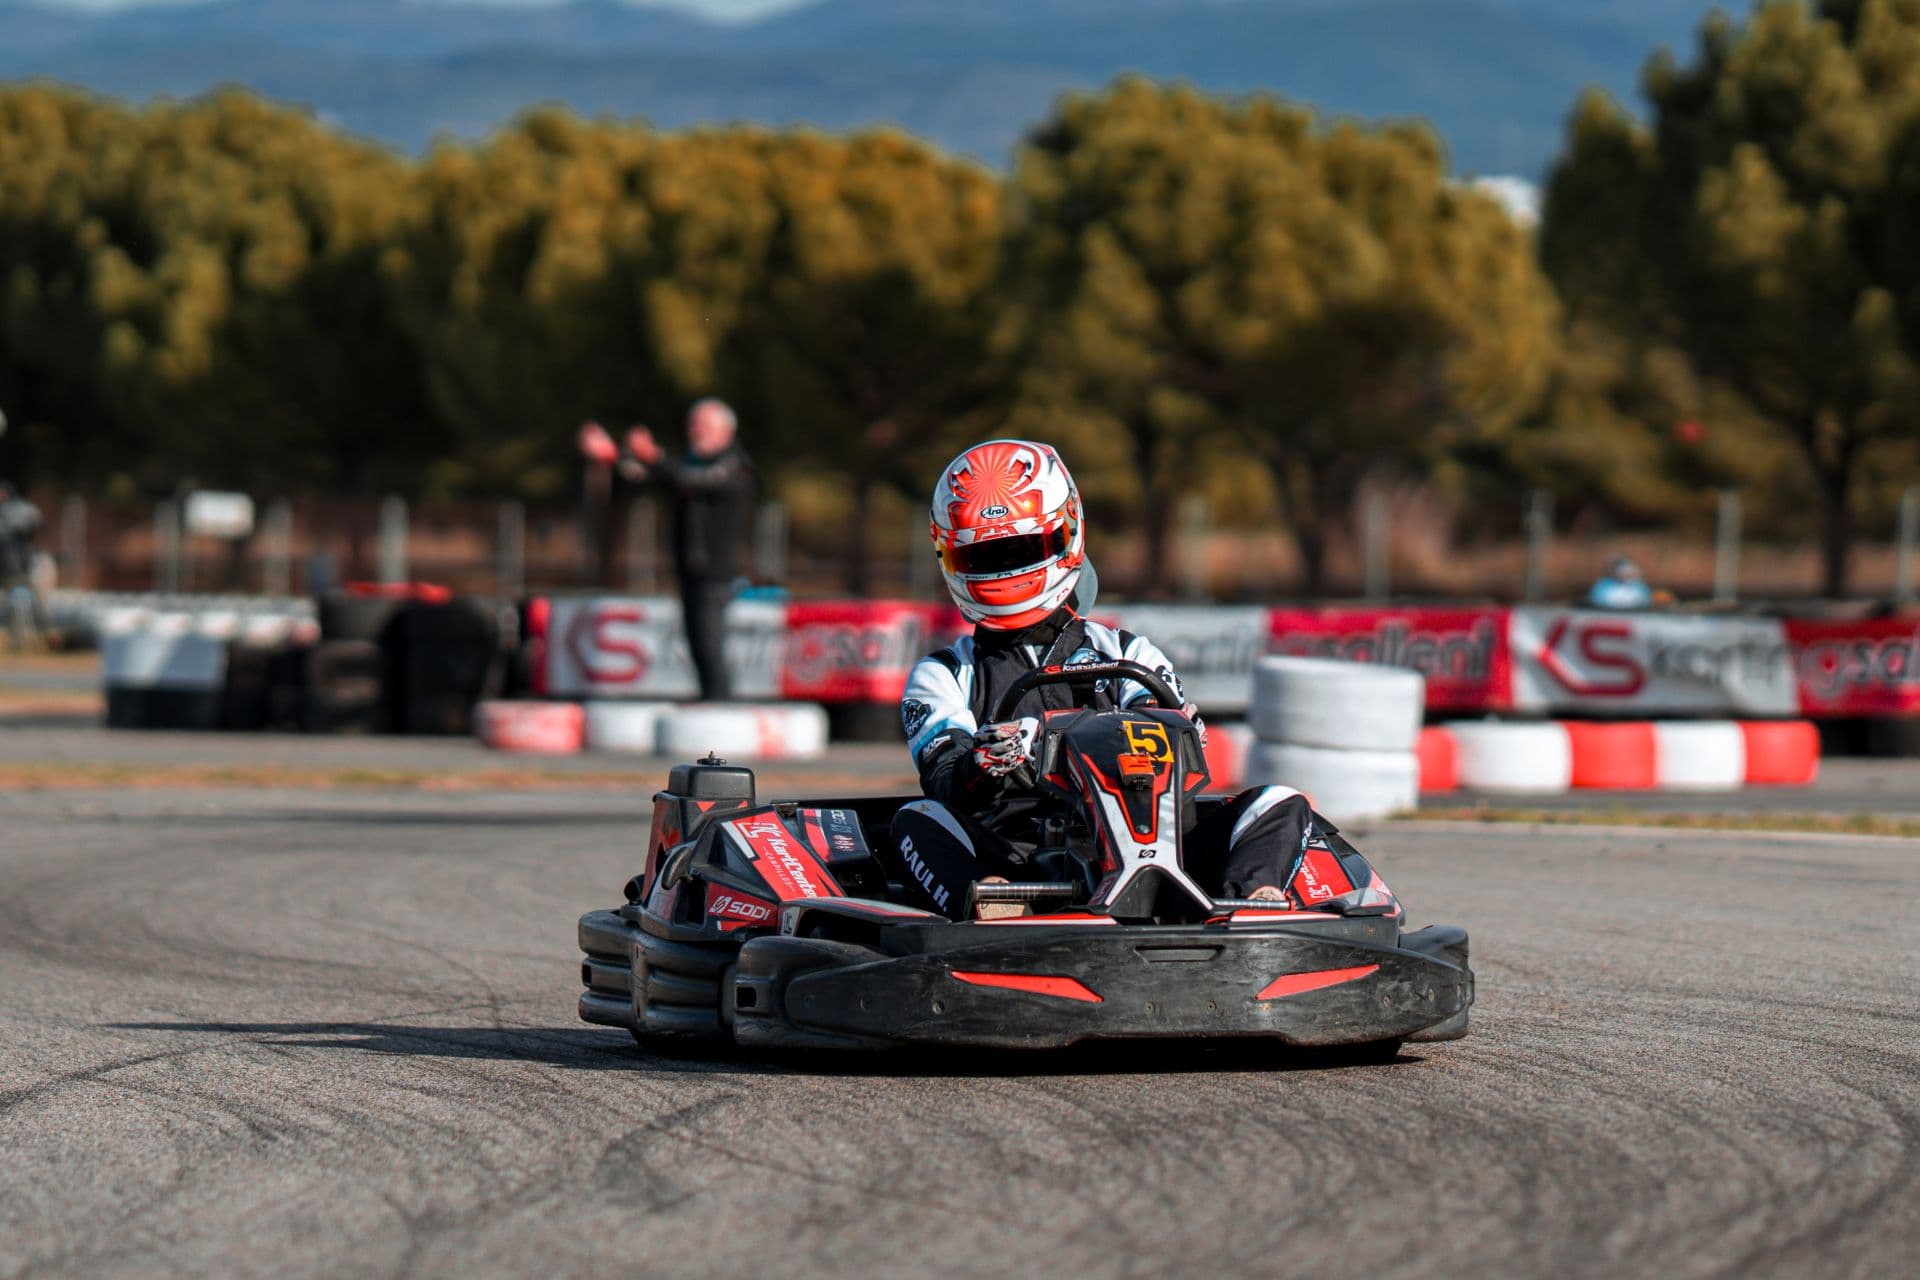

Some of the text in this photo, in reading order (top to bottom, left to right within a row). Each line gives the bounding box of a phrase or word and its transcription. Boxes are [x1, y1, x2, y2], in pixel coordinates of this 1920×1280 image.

[985, 506, 1005, 516] Arai
[1536, 614, 1648, 696] KS
[1131, 723, 1168, 759] 5
[900, 834, 950, 913] RAUL H.
